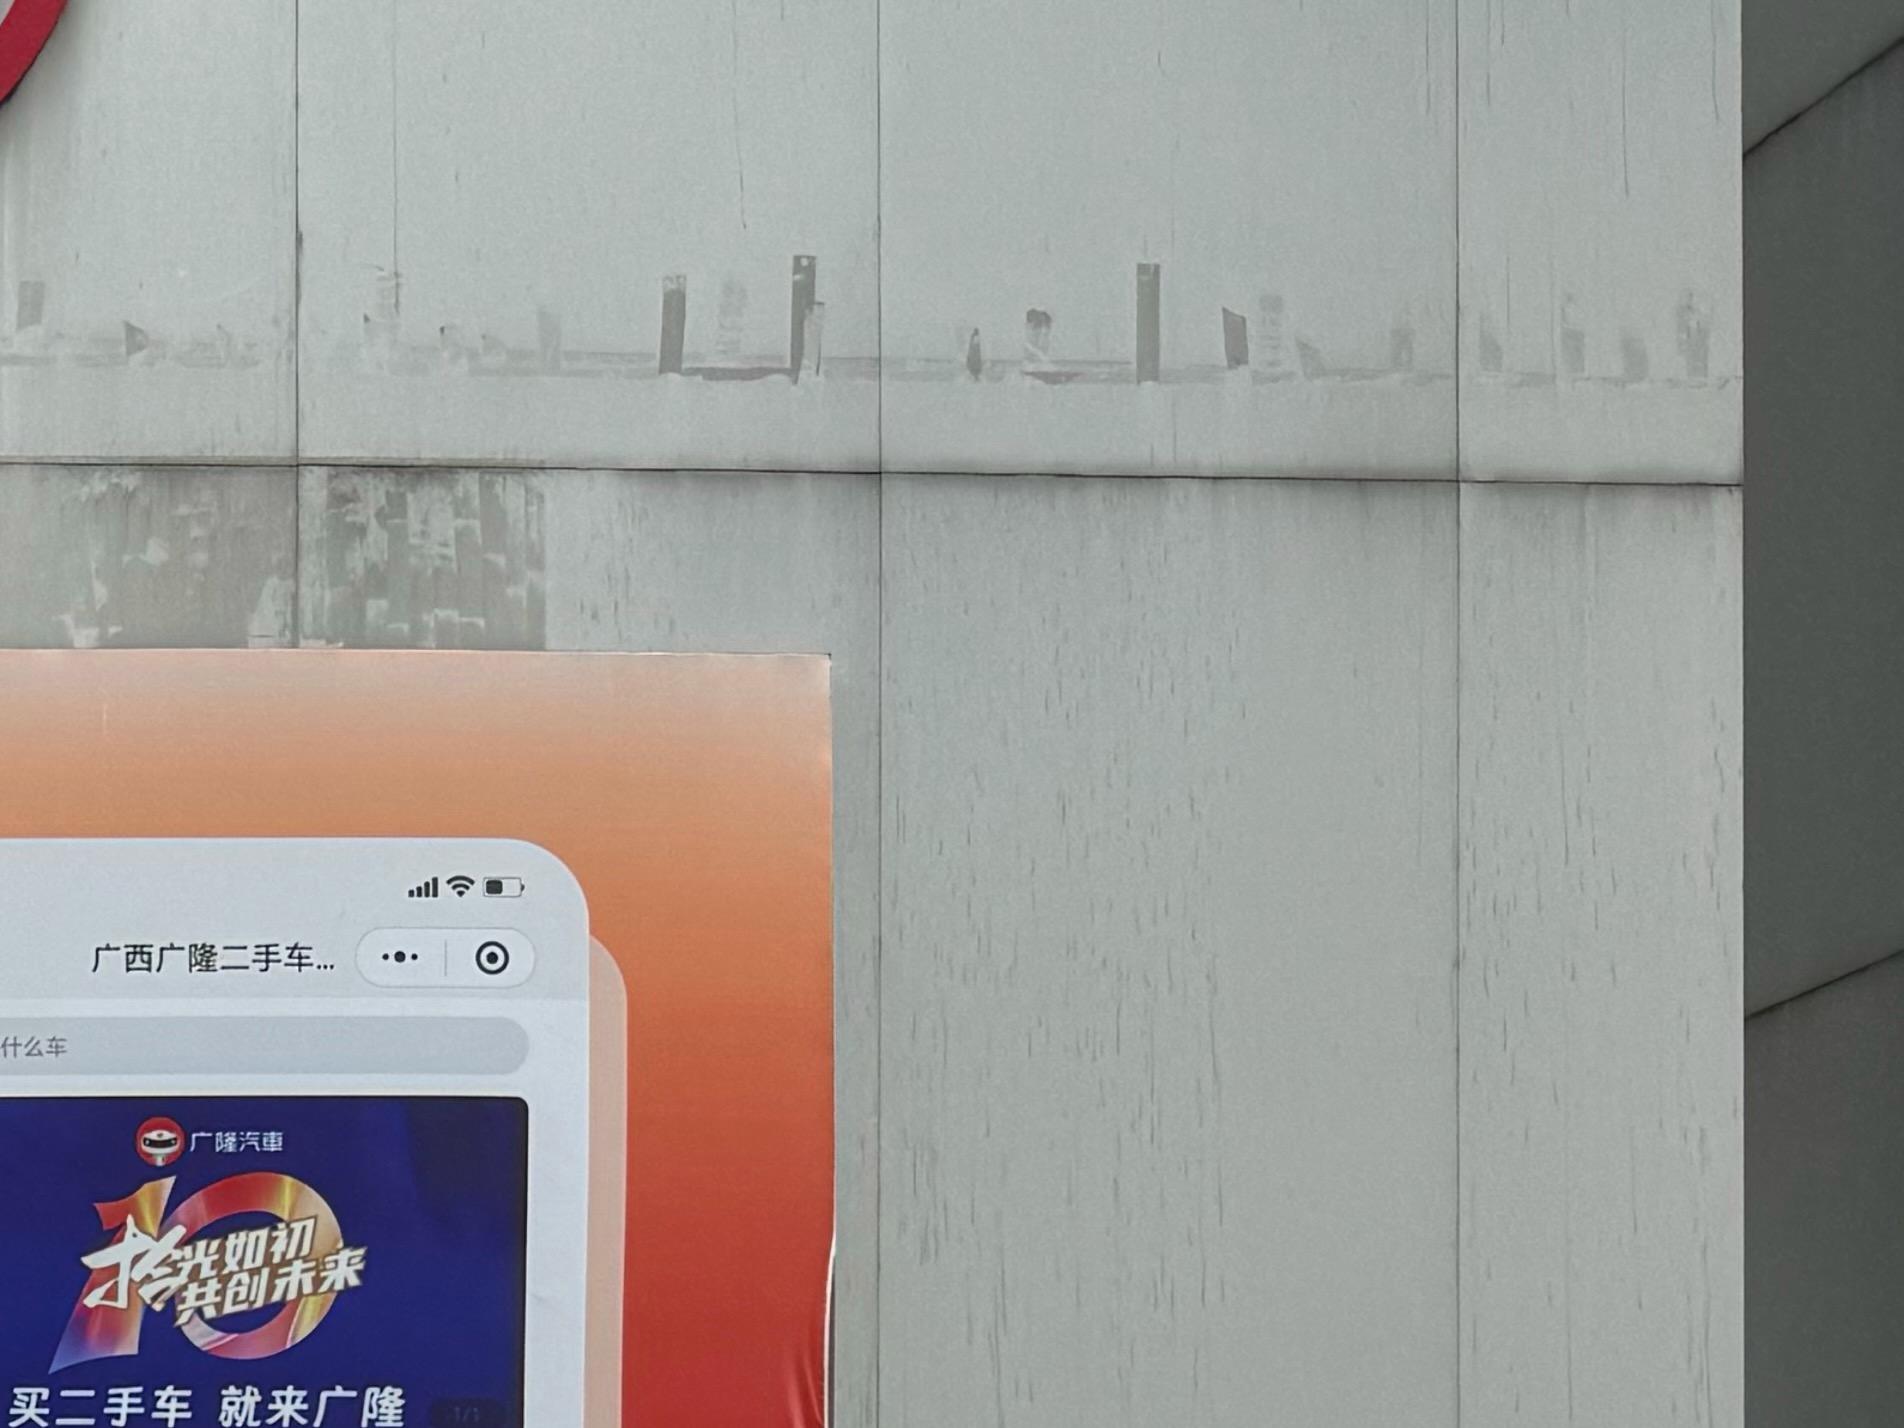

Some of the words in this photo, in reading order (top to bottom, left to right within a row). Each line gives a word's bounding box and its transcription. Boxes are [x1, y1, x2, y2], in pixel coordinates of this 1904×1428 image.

[190, 1130, 285, 1154] 广隆汽車
[175, 1245, 368, 1326] 共创未来
[9, 1385, 192, 1428] 买二手车
[219, 1385, 405, 1427] 就来广隆
